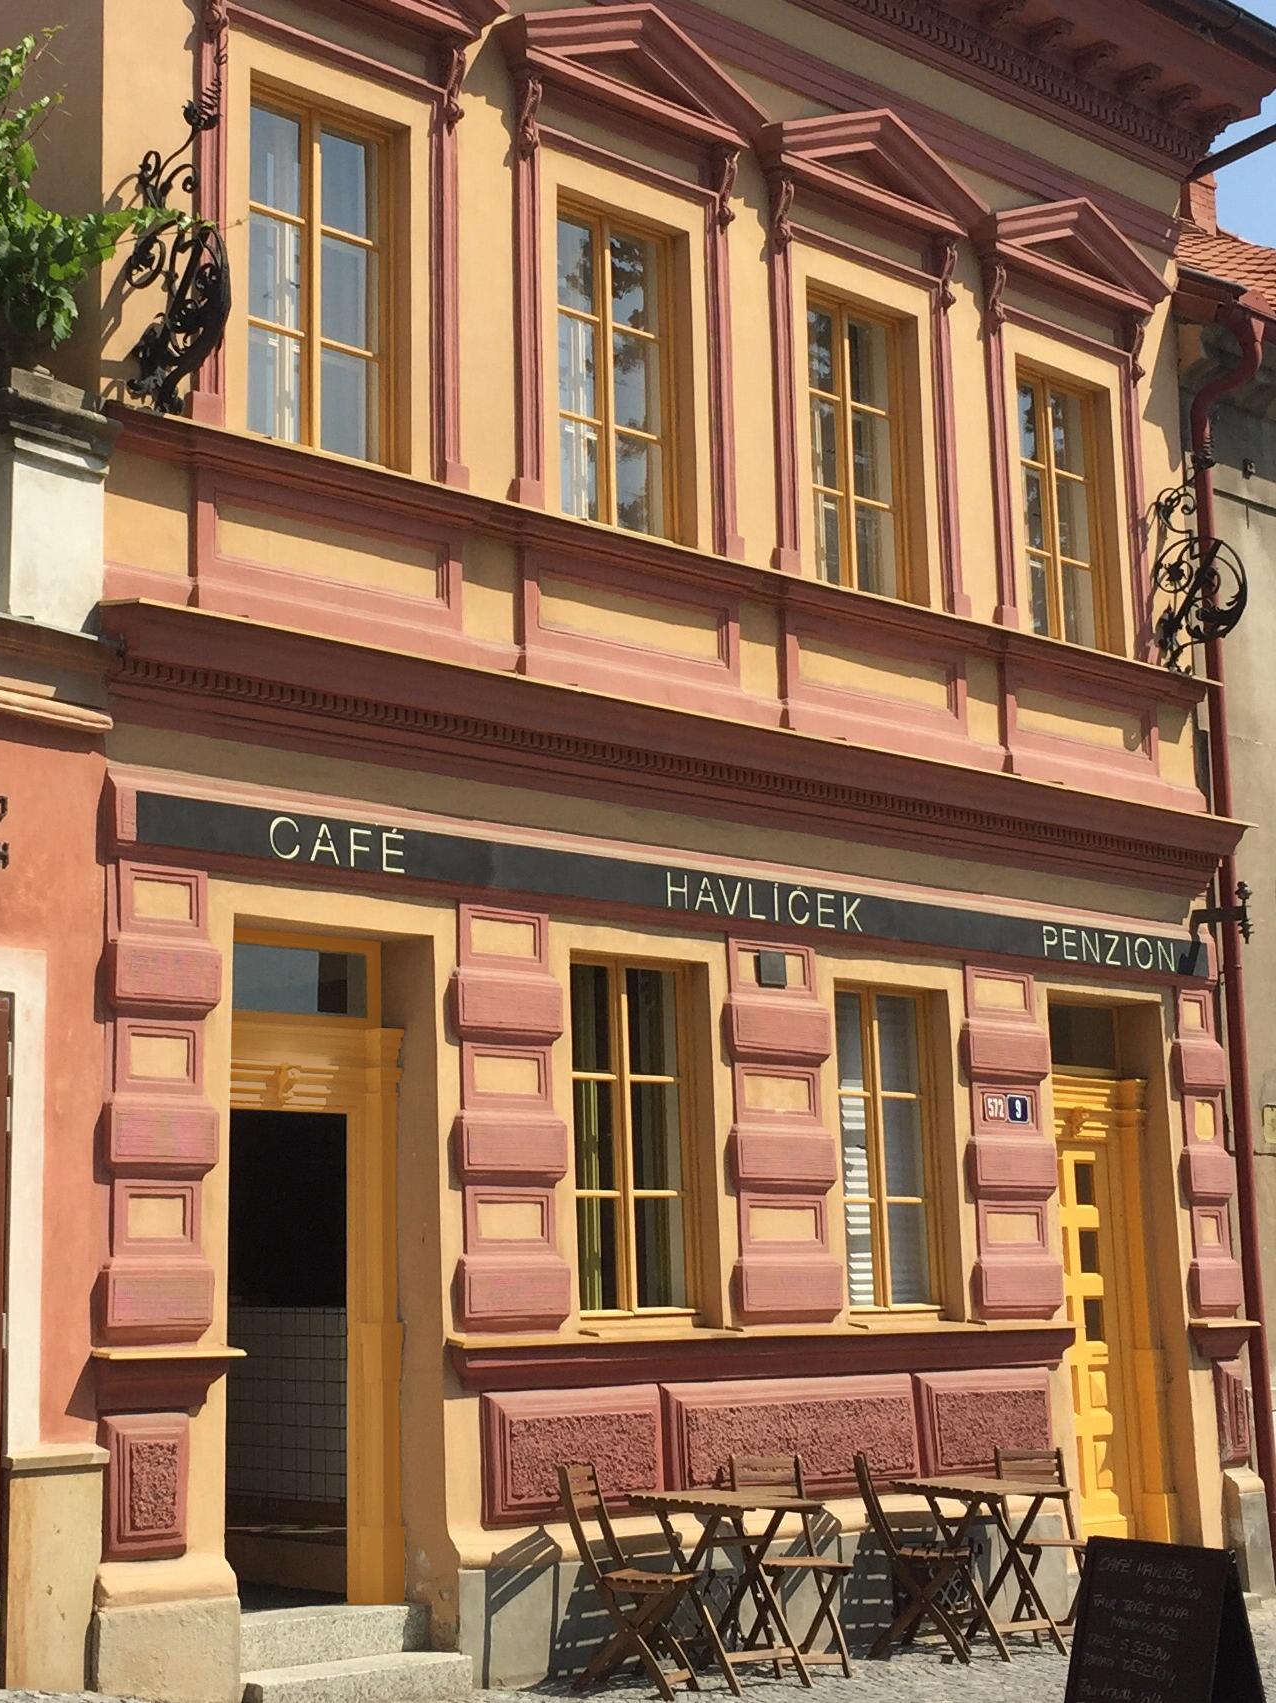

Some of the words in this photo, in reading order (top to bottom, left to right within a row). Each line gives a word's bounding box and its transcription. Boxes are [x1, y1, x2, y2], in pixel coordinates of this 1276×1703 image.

[269, 816, 406, 874] CAFÉ
[666, 871, 863, 932] HAVLÍČEK
[1042, 925, 1176, 972] PENZION
[987, 1097, 1005, 1118] 572
[1015, 1099, 1022, 1119] 9
